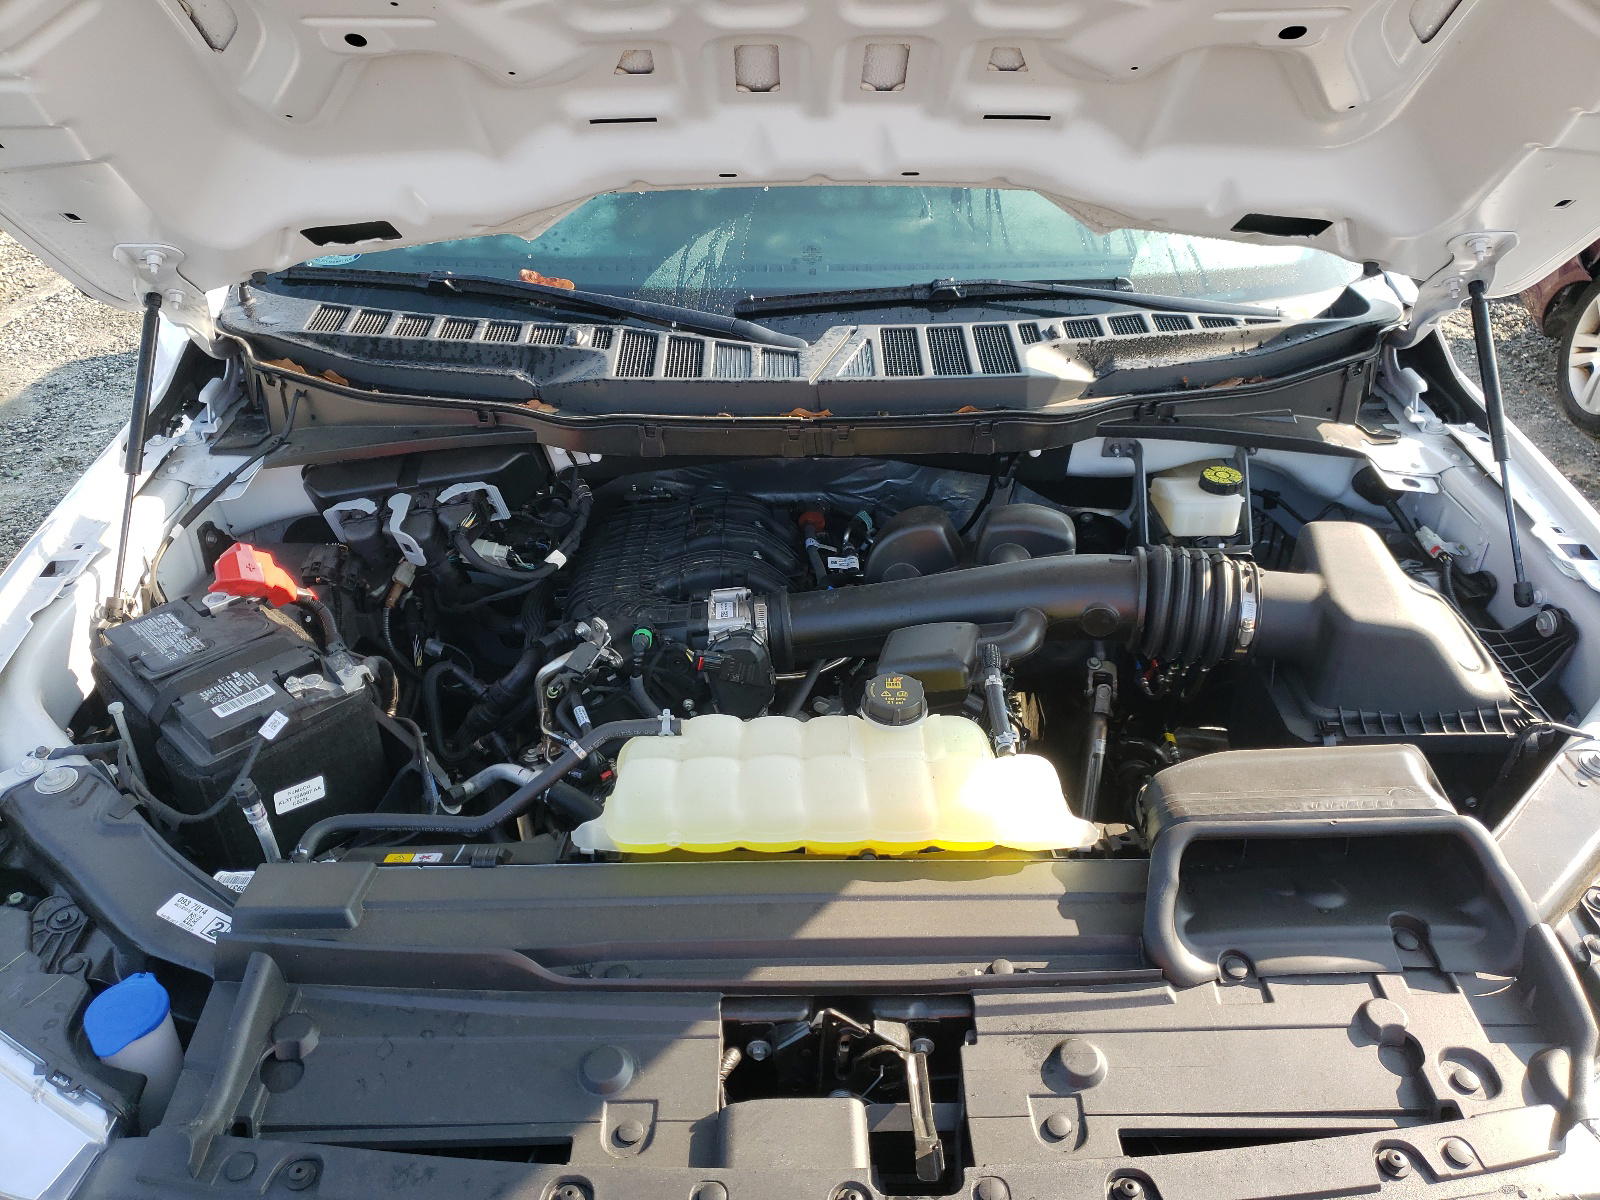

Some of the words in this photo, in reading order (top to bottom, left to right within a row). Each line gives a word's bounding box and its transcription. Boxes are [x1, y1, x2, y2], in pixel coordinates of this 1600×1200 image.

[177, 896, 192, 907] 093
[191, 903, 209, 915] 7014
[206, 922, 225, 936] 2
